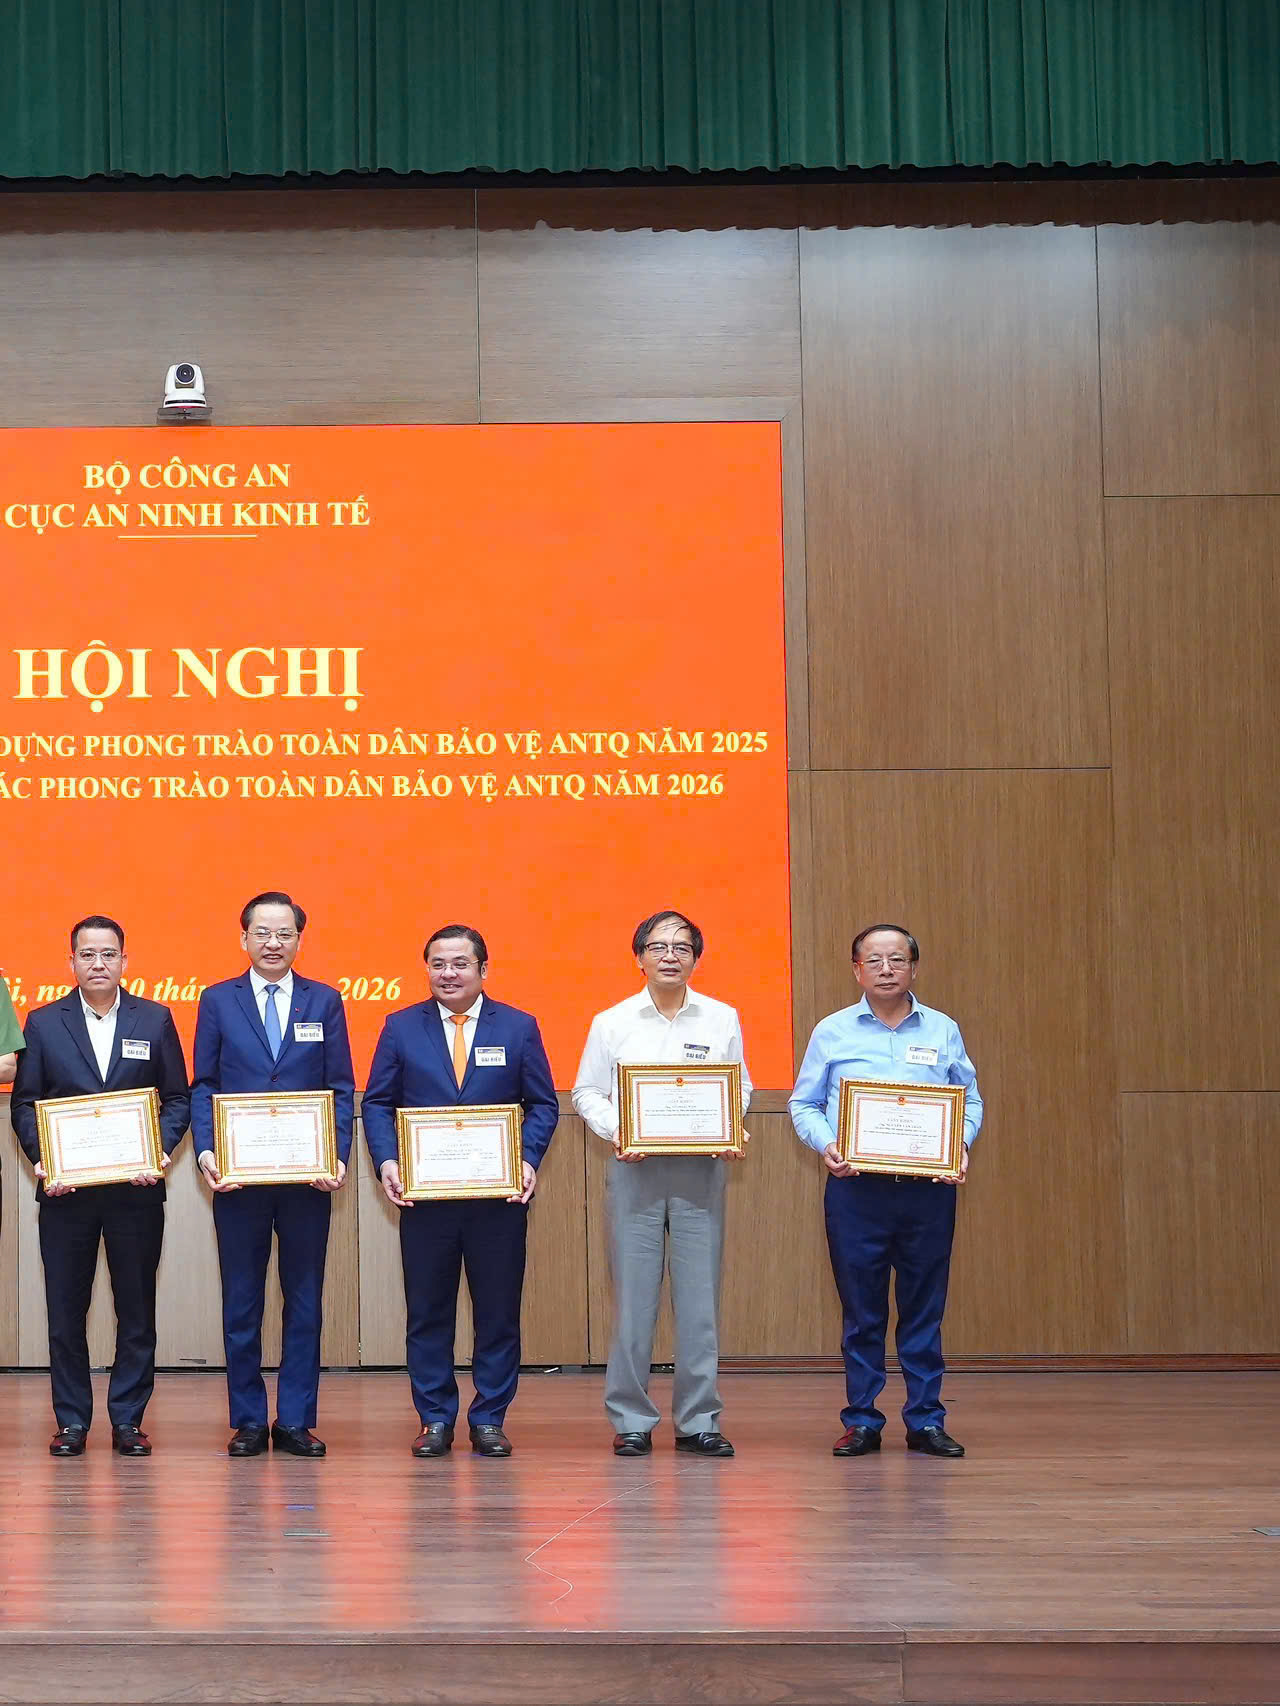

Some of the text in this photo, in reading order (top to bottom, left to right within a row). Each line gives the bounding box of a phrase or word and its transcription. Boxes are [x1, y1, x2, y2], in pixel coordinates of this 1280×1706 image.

[83, 455, 291, 496] BỘ CÔNG AN
[4, 494, 371, 535] CỤC AN NINH KINH TẾ
[12, 639, 365, 713] HỘI NGHỊ
[82, 734, 187, 757] PHONG
[192, 728, 274, 757] TRÀO
[279, 727, 361, 756] TOÀN
[367, 727, 430, 756] DÂN
[435, 726, 497, 755] BẢO
[503, 729, 543, 761] VỆ
[548, 731, 630, 759] ANTQ
[636, 726, 705, 754] NĂM
[711, 731, 769, 753] 2025
[39, 775, 143, 799] PHONG
[148, 770, 230, 799] TRÀO
[235, 769, 317, 799] TOÀN
[323, 769, 385, 798] DÂN
[391, 768, 453, 797] BẢO
[458, 772, 499, 803] VỆ
[503, 773, 586, 801] ANTQ
[592, 769, 660, 796] NĂM
[667, 773, 724, 796] 2026
[337, 976, 402, 1001] 2026
